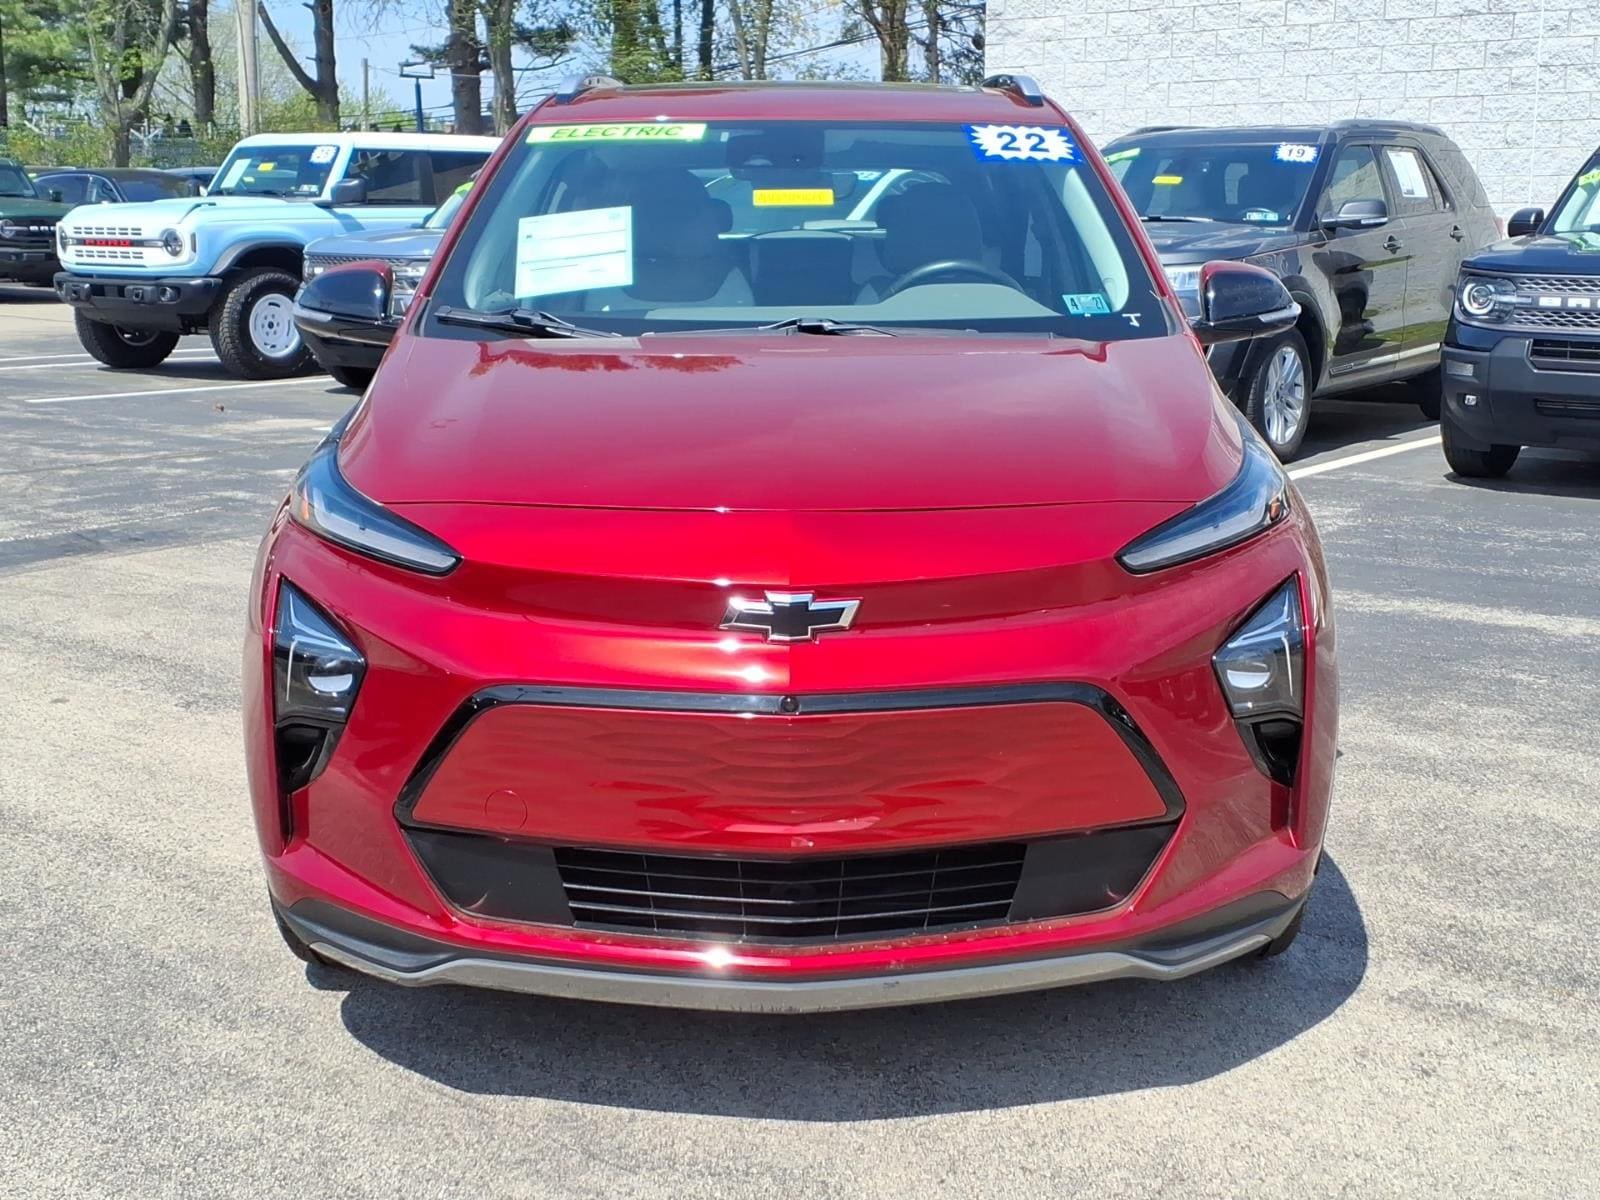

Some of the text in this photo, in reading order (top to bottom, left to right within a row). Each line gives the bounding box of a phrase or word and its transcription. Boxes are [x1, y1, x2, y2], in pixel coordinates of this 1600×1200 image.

[551, 126, 684, 139] ELECTRIC
[996, 132, 1050, 153] 22
[1286, 148, 1305, 158] 19
[85, 238, 130, 247] FORD
[1070, 297, 1080, 311] 4
